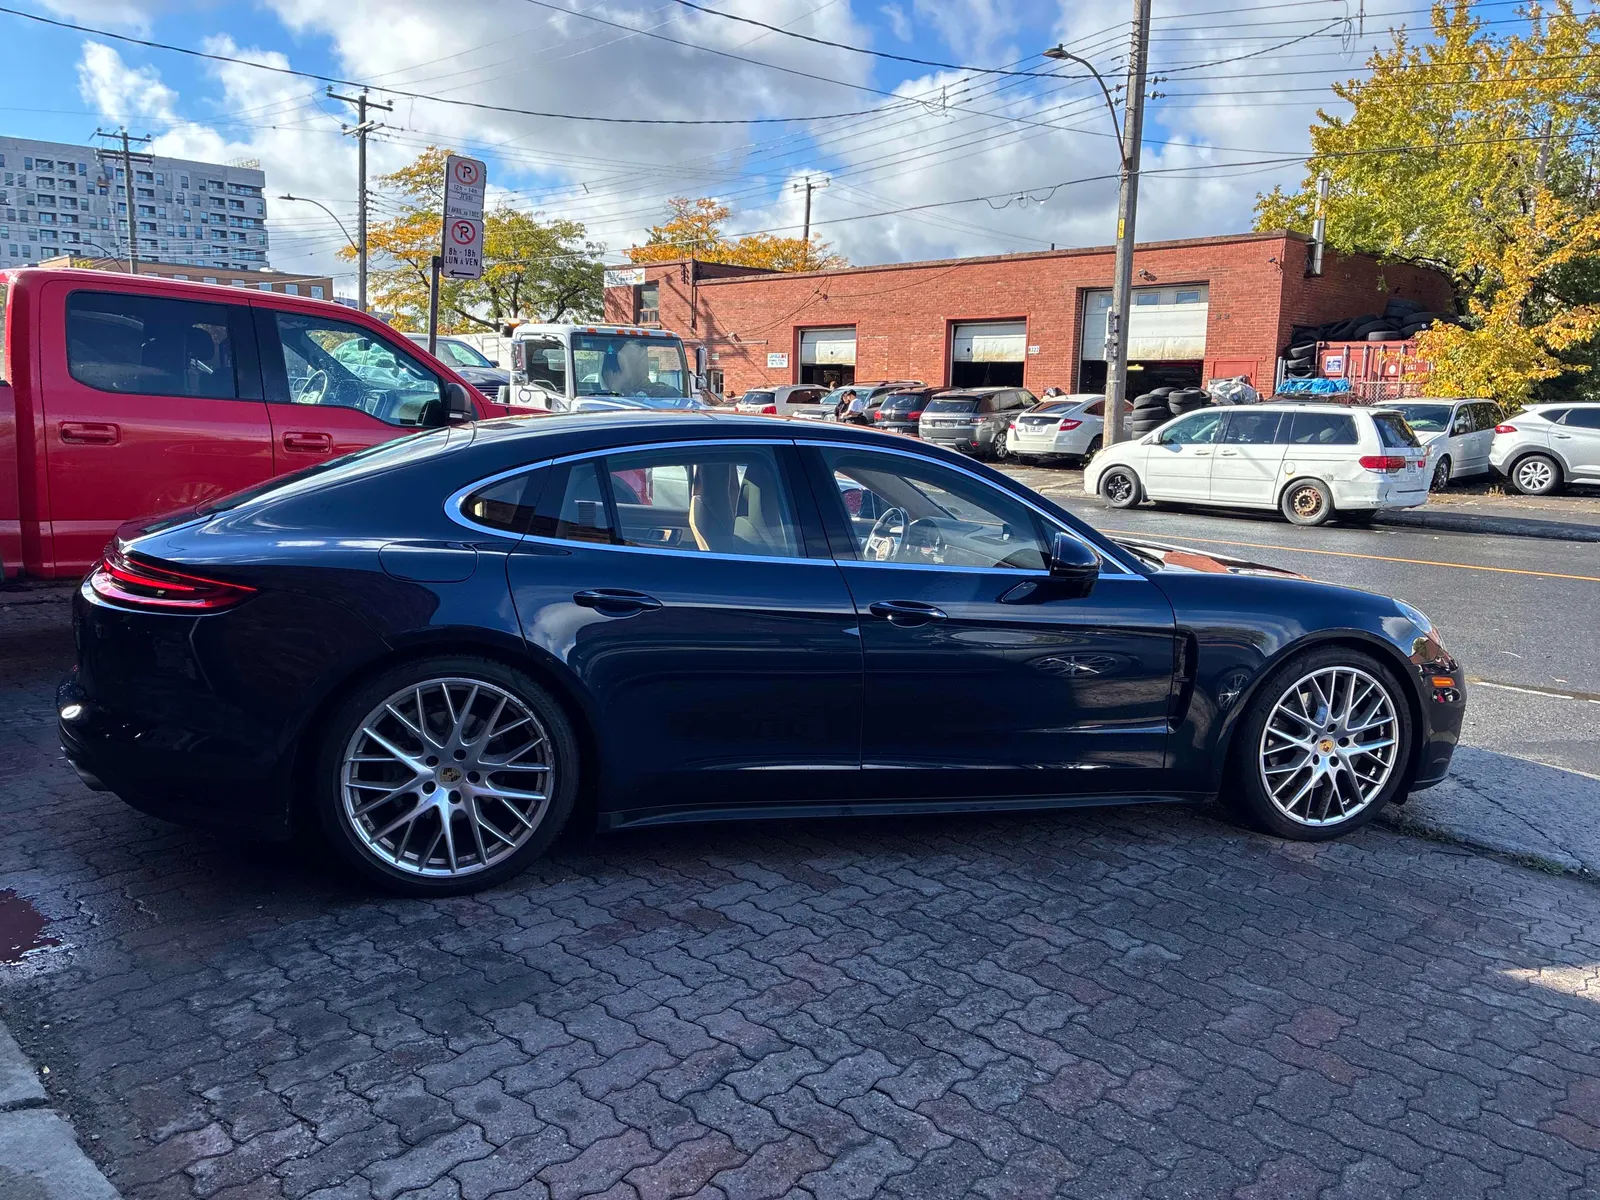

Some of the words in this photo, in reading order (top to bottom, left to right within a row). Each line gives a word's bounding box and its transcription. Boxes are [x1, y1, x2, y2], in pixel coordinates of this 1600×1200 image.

[453, 184, 463, 192] 12h
[460, 225, 469, 238] P
[448, 247, 458, 256] 8h
[464, 249, 476, 258] 18h
[445, 255, 459, 265] LUN
[465, 257, 479, 267] VEN
